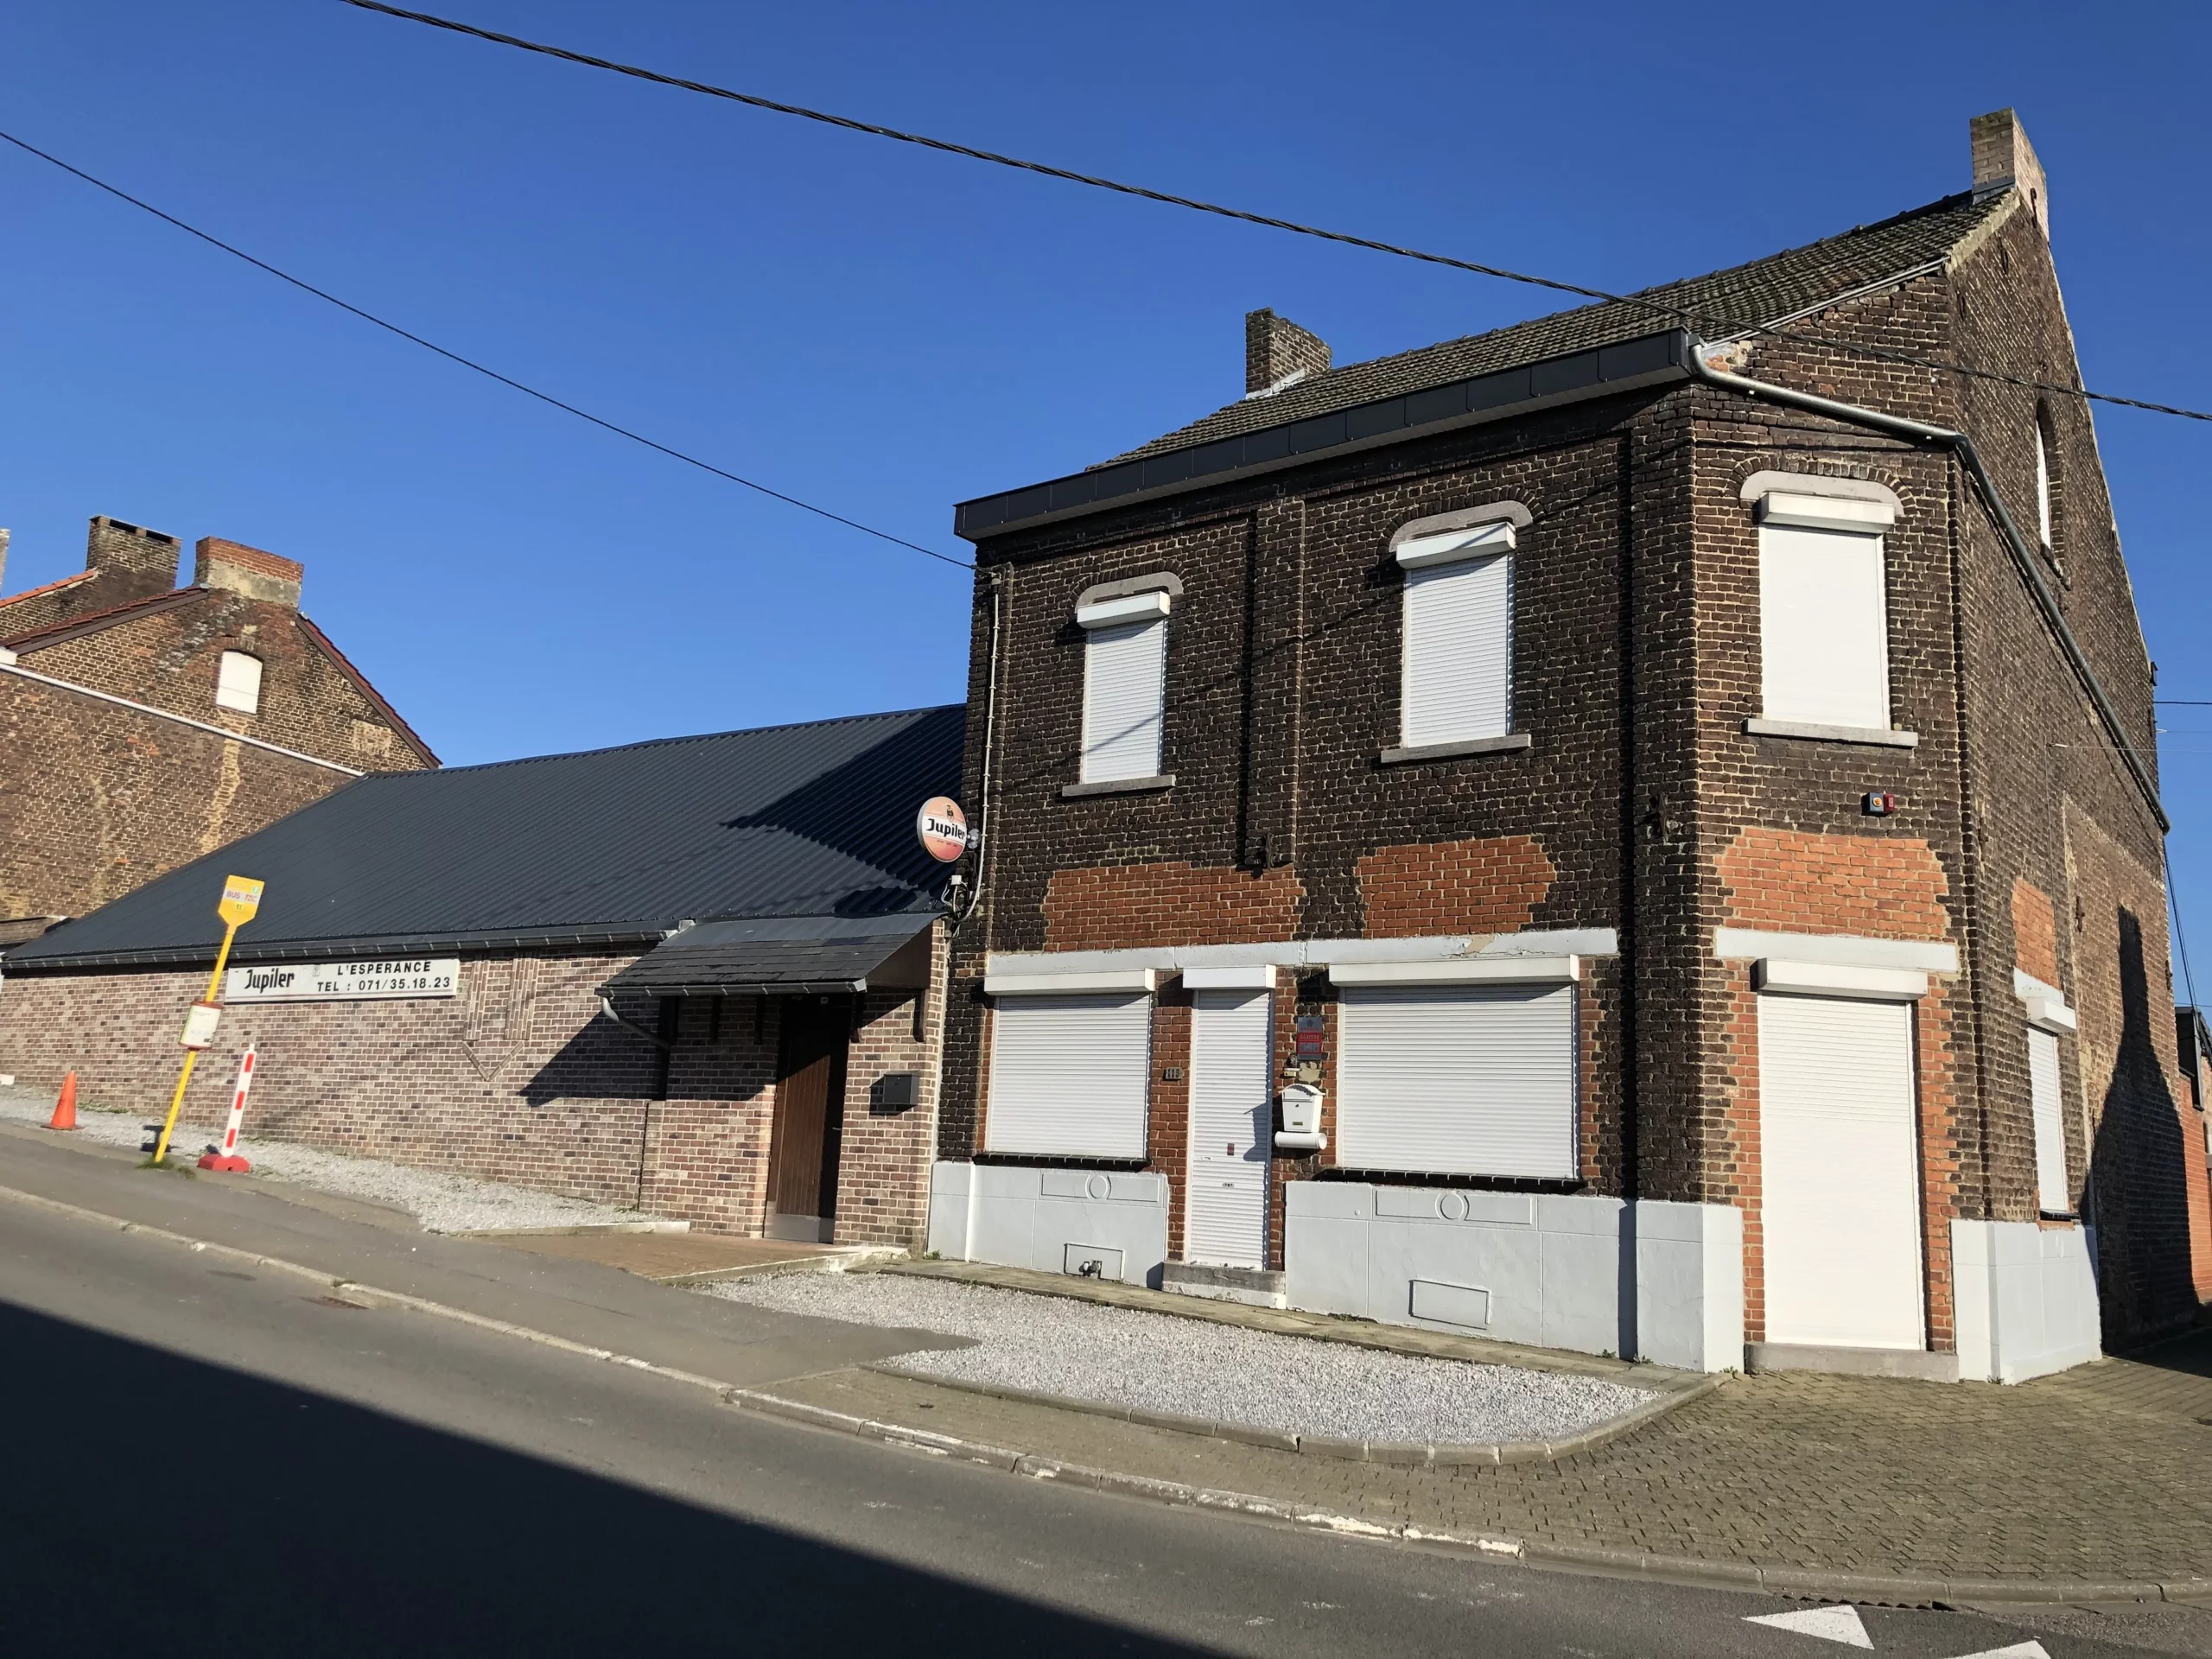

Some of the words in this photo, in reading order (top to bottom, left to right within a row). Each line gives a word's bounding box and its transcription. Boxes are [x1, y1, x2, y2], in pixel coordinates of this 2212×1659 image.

[926, 818, 966, 840] Jupiler
[226, 891, 241, 899] BUS
[338, 961, 431, 976] L'ESPERANCE
[245, 968, 295, 994] Jupiler
[317, 982, 340, 992] TEL
[359, 977, 450, 990] 071/35.18.23
[1167, 1068, 1180, 1077] 115
